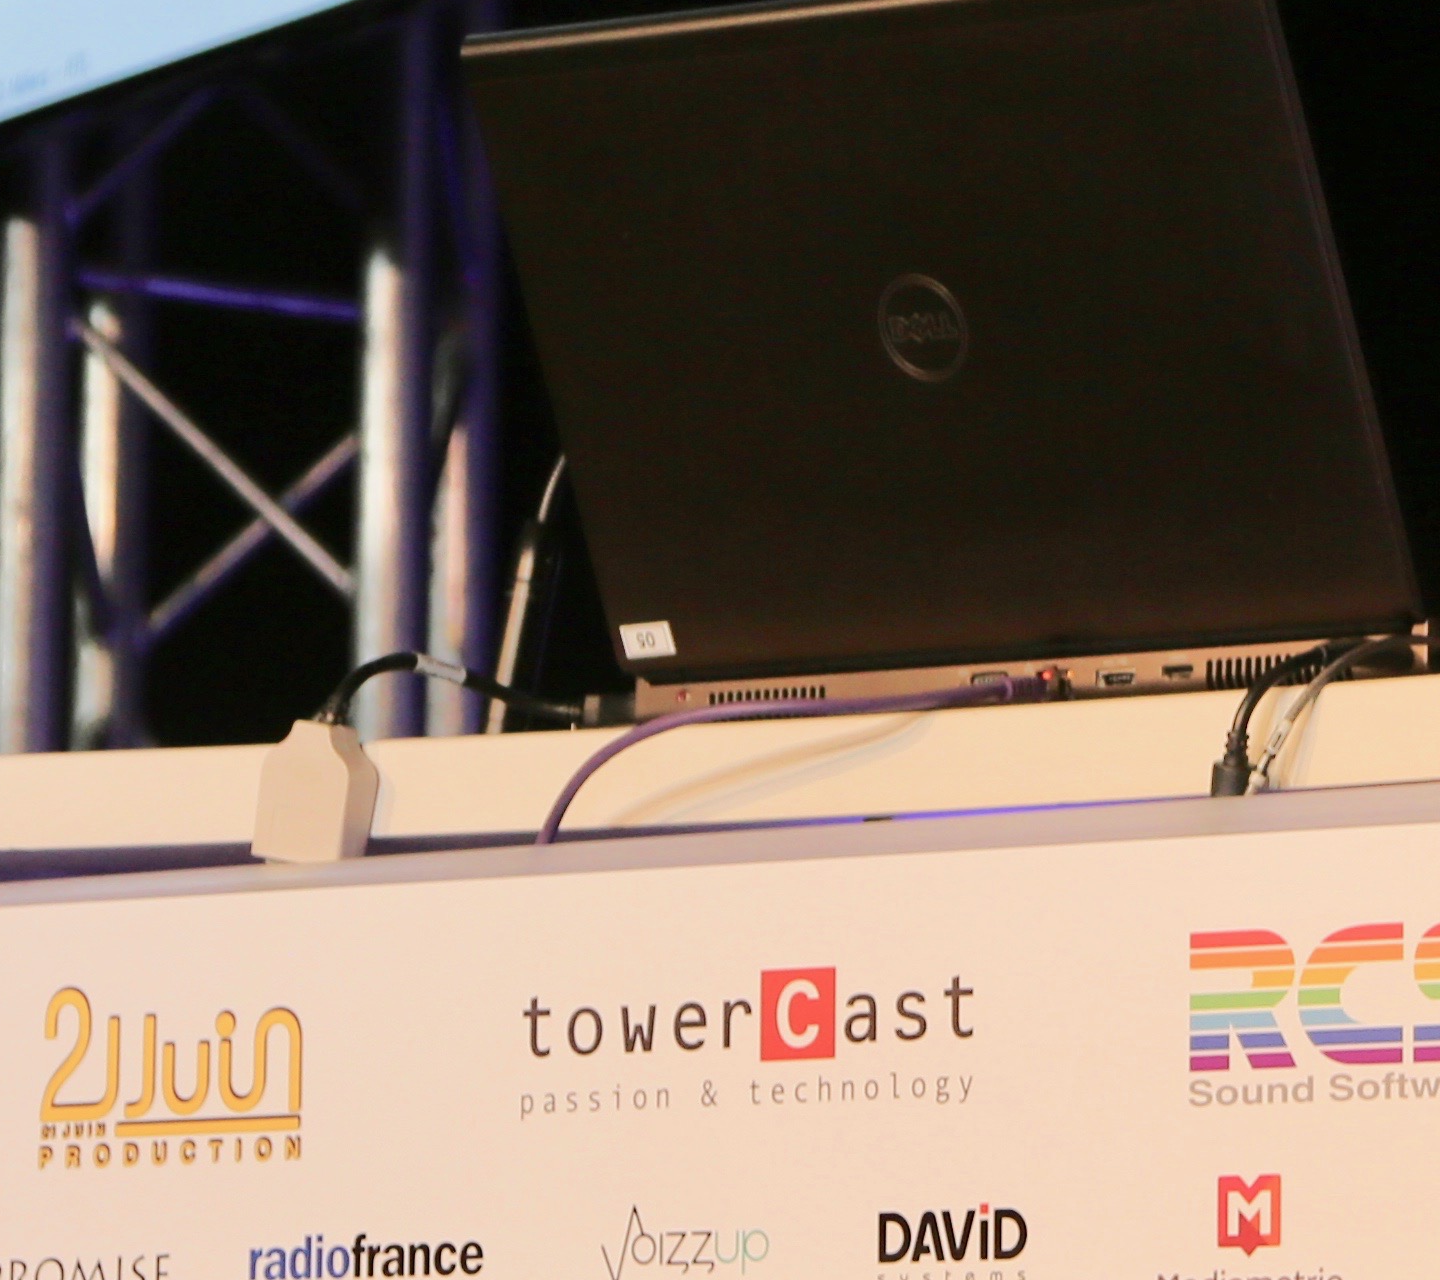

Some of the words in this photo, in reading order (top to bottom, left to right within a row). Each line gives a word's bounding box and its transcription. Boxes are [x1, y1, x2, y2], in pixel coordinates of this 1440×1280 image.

[523, 972, 975, 1059] towerCast
[520, 1085, 670, 1119] passion
[700, 1080, 718, 1107] &
[749, 1070, 974, 1106] technology
[1188, 1076, 1315, 1108] Sound
[38, 1136, 302, 1169] PRODUCTION
